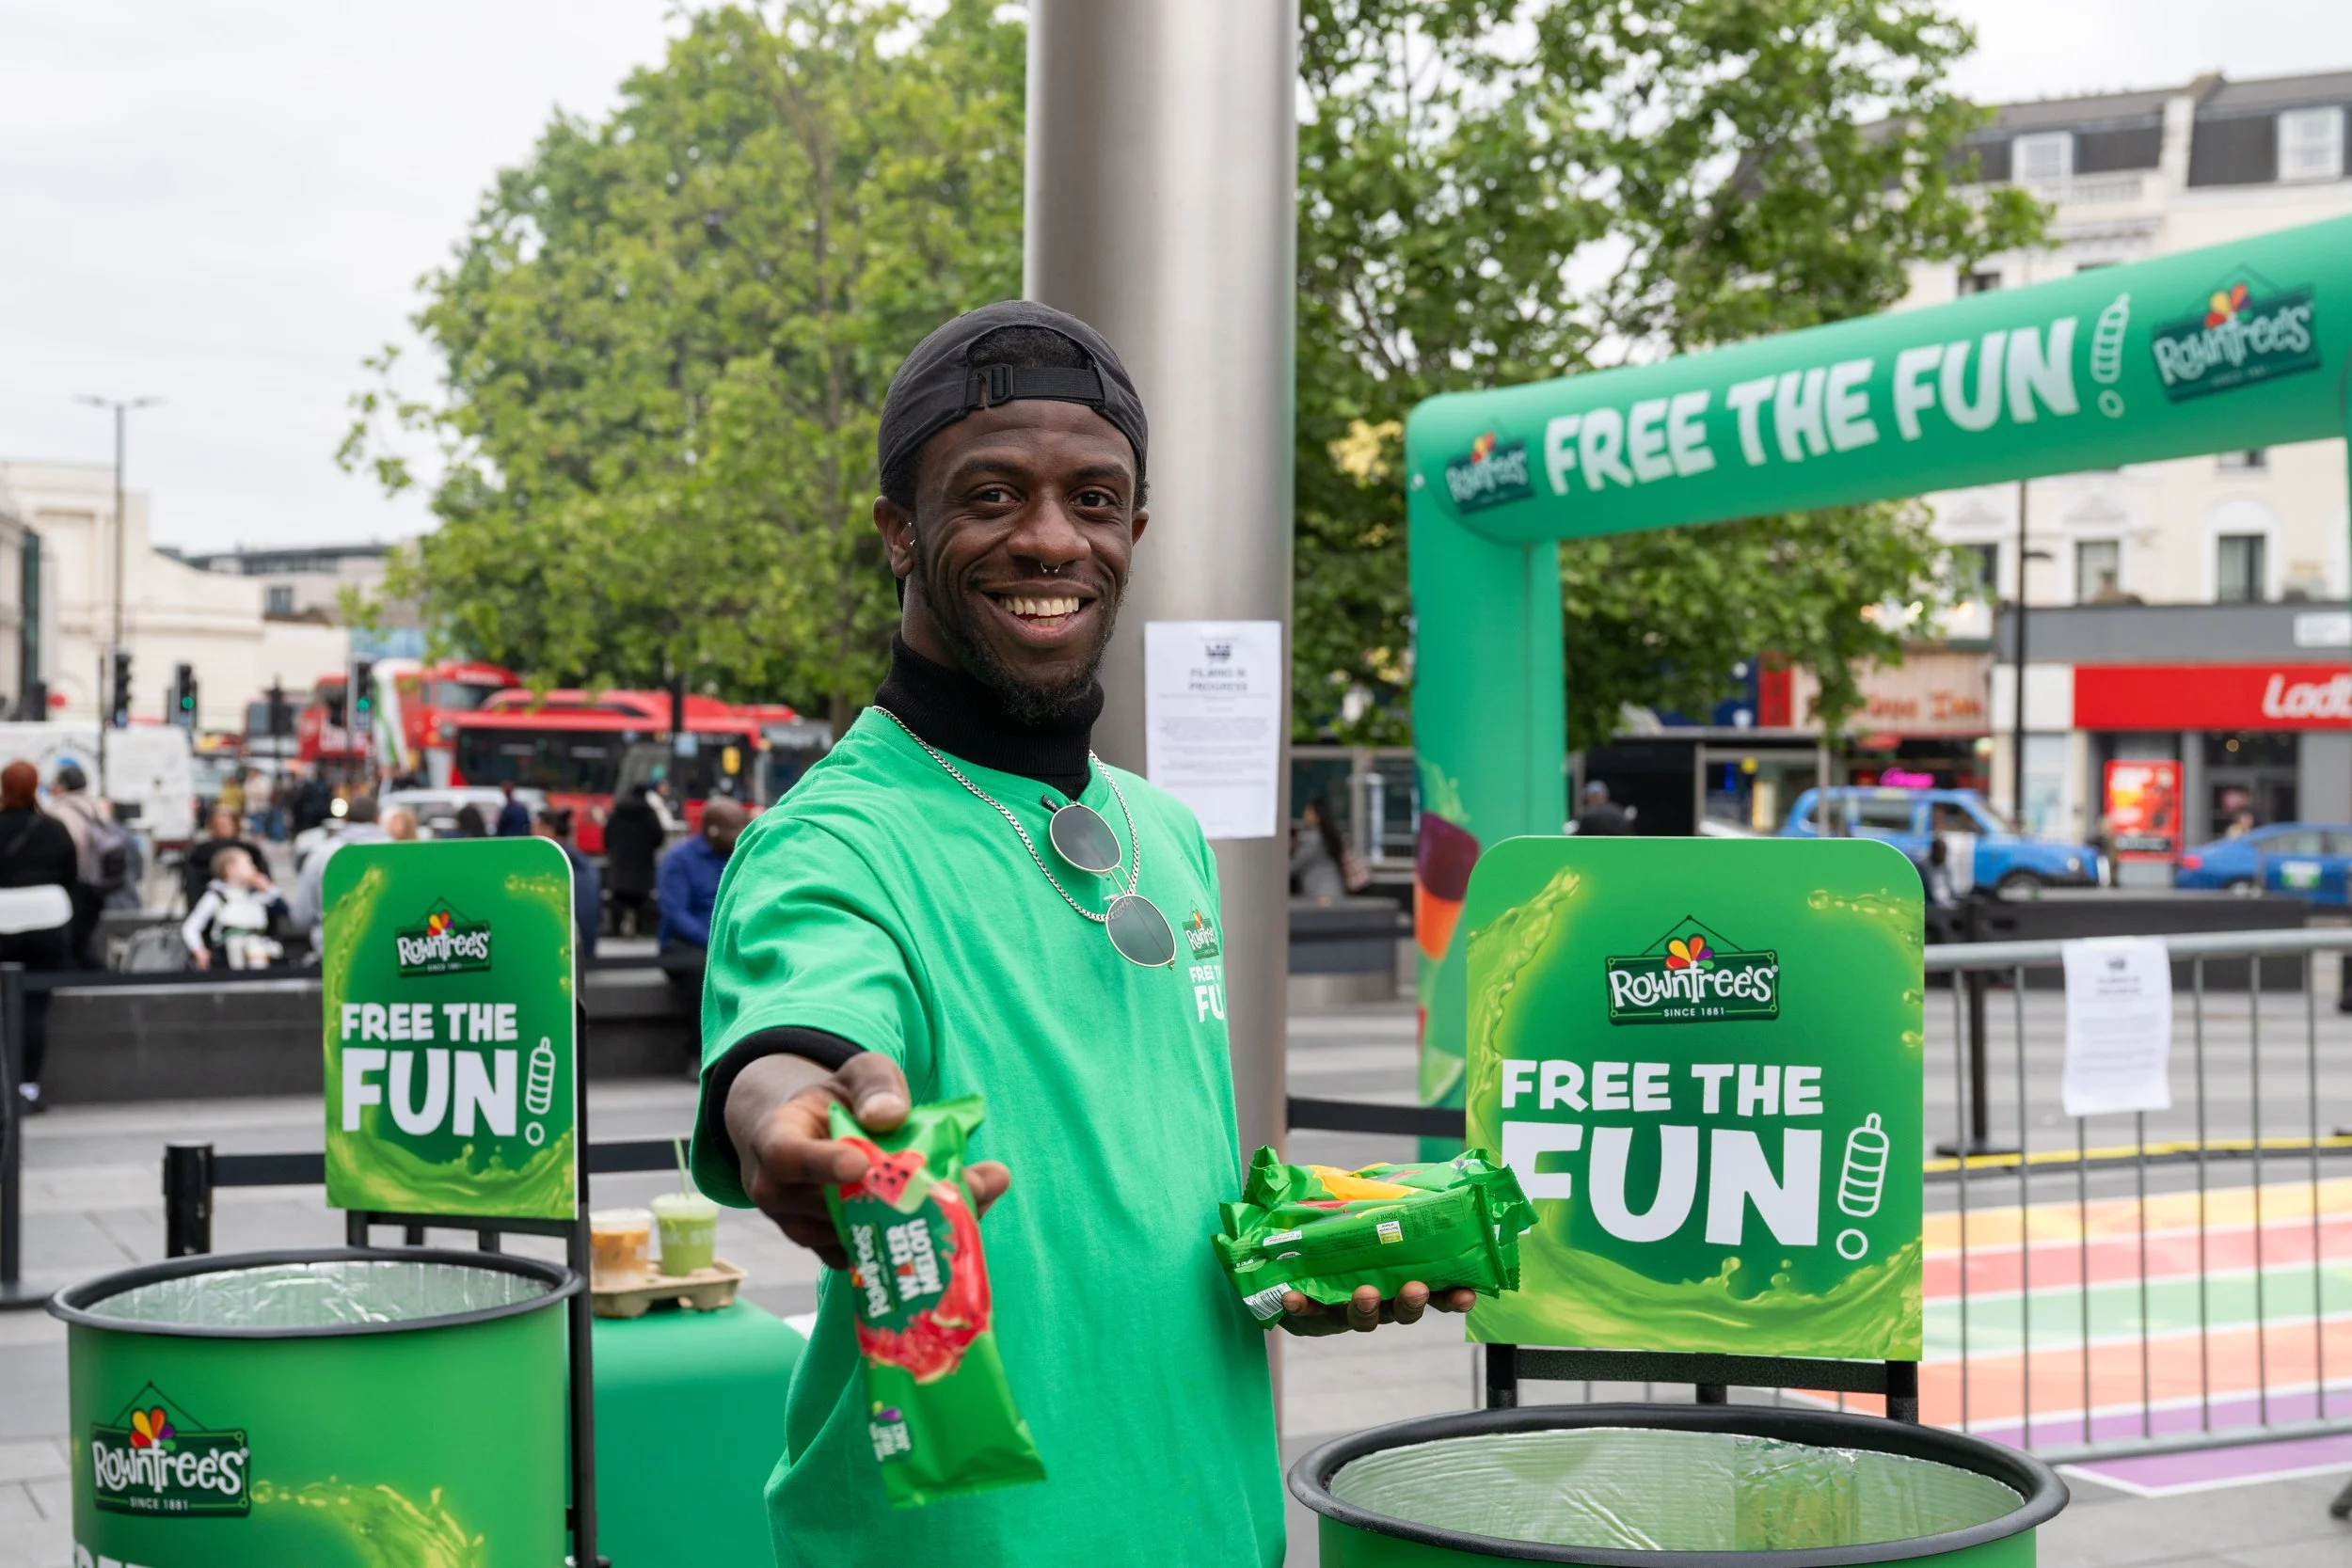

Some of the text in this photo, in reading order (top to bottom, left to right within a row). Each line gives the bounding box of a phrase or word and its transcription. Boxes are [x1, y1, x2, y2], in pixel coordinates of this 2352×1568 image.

[1544, 389, 1717, 496] FREE
[1725, 358, 1880, 467] THE
[397, 928, 489, 966] Rowntree's
[1194, 984, 1225, 1022] FU
[1609, 960, 1774, 1007] Rowntree's
[341, 1003, 517, 1042] FREE THE
[1663, 1006, 1725, 1017] SINCE 1881
[1502, 1059, 1823, 1117] FREE THE
[92, 1438, 243, 1496] Rowntree's
[130, 1496, 188, 1512] SINCE 1881
